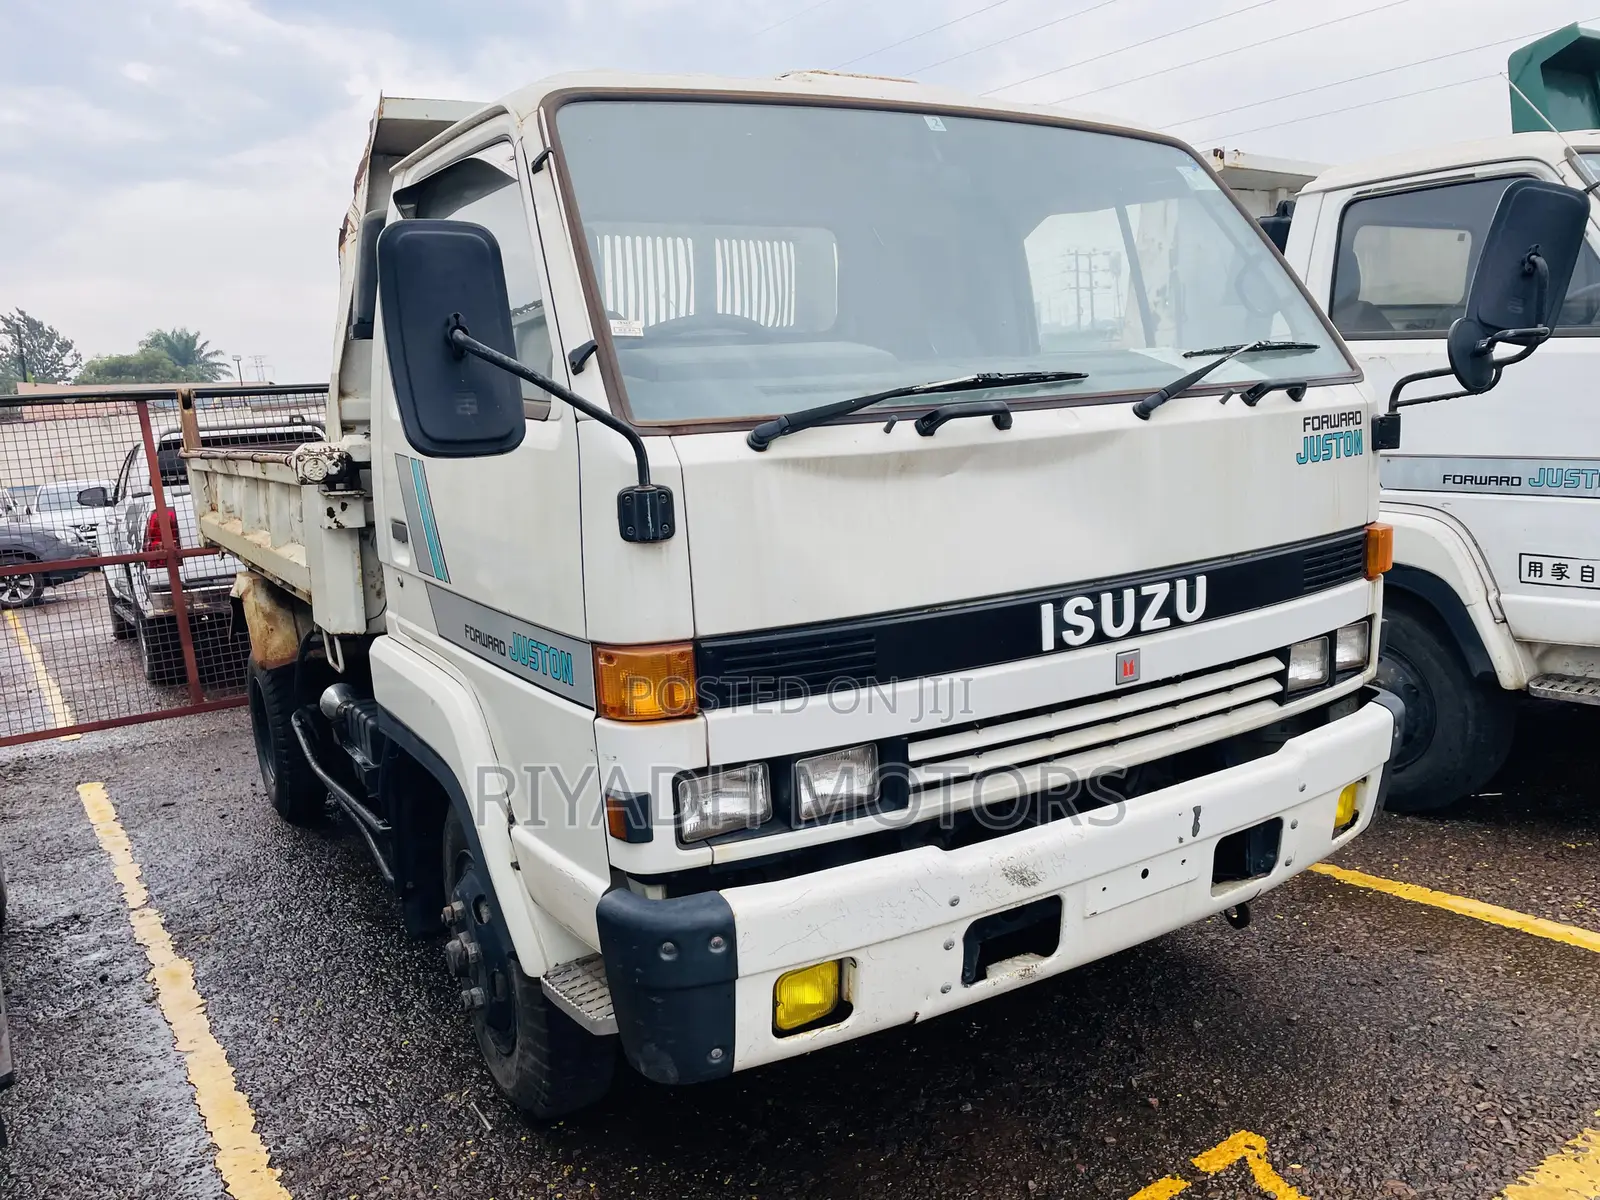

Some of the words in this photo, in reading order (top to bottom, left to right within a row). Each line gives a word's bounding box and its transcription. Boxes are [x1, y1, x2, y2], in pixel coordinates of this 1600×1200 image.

[1303, 411, 1362, 432] FORWARD
[1296, 429, 1363, 465] JUSTON
[1443, 473, 1521, 487] FORWARD
[1528, 468, 1600, 489] JUST
[1040, 575, 1208, 652] ISUZU
[464, 624, 506, 657] FORWARD
[508, 632, 574, 686] JUSTON
